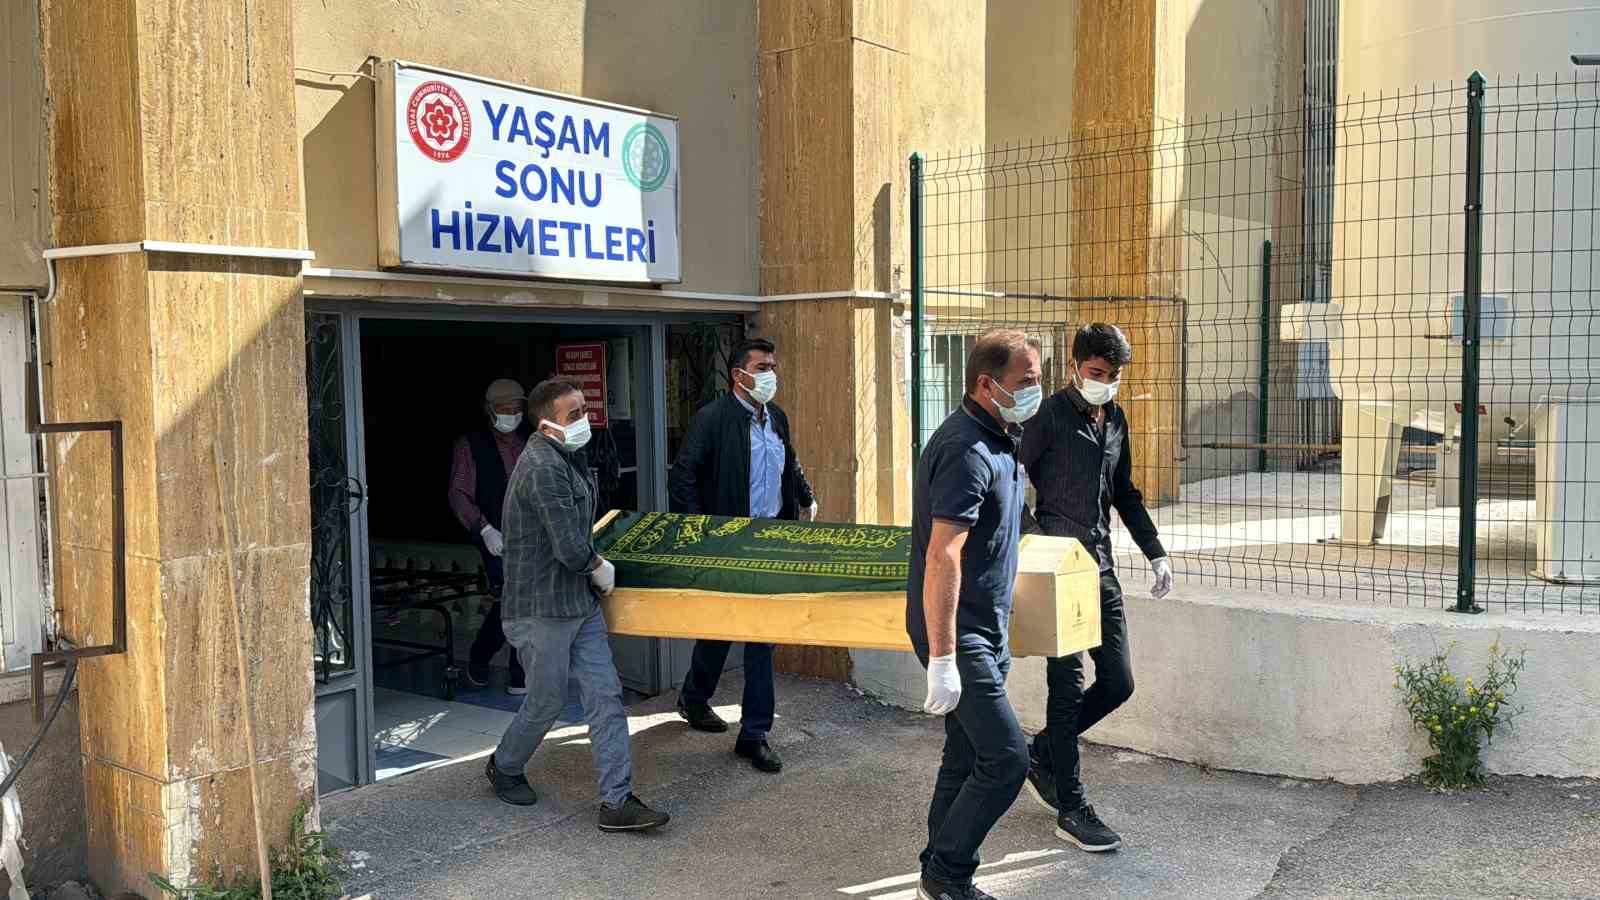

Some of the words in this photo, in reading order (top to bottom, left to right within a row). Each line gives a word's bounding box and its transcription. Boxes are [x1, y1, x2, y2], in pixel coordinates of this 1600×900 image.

[432, 151, 450, 159] 1974
[482, 99, 610, 159] YAŞAM
[495, 159, 602, 208] SONU
[431, 200, 656, 264] HİZMETLERİ
